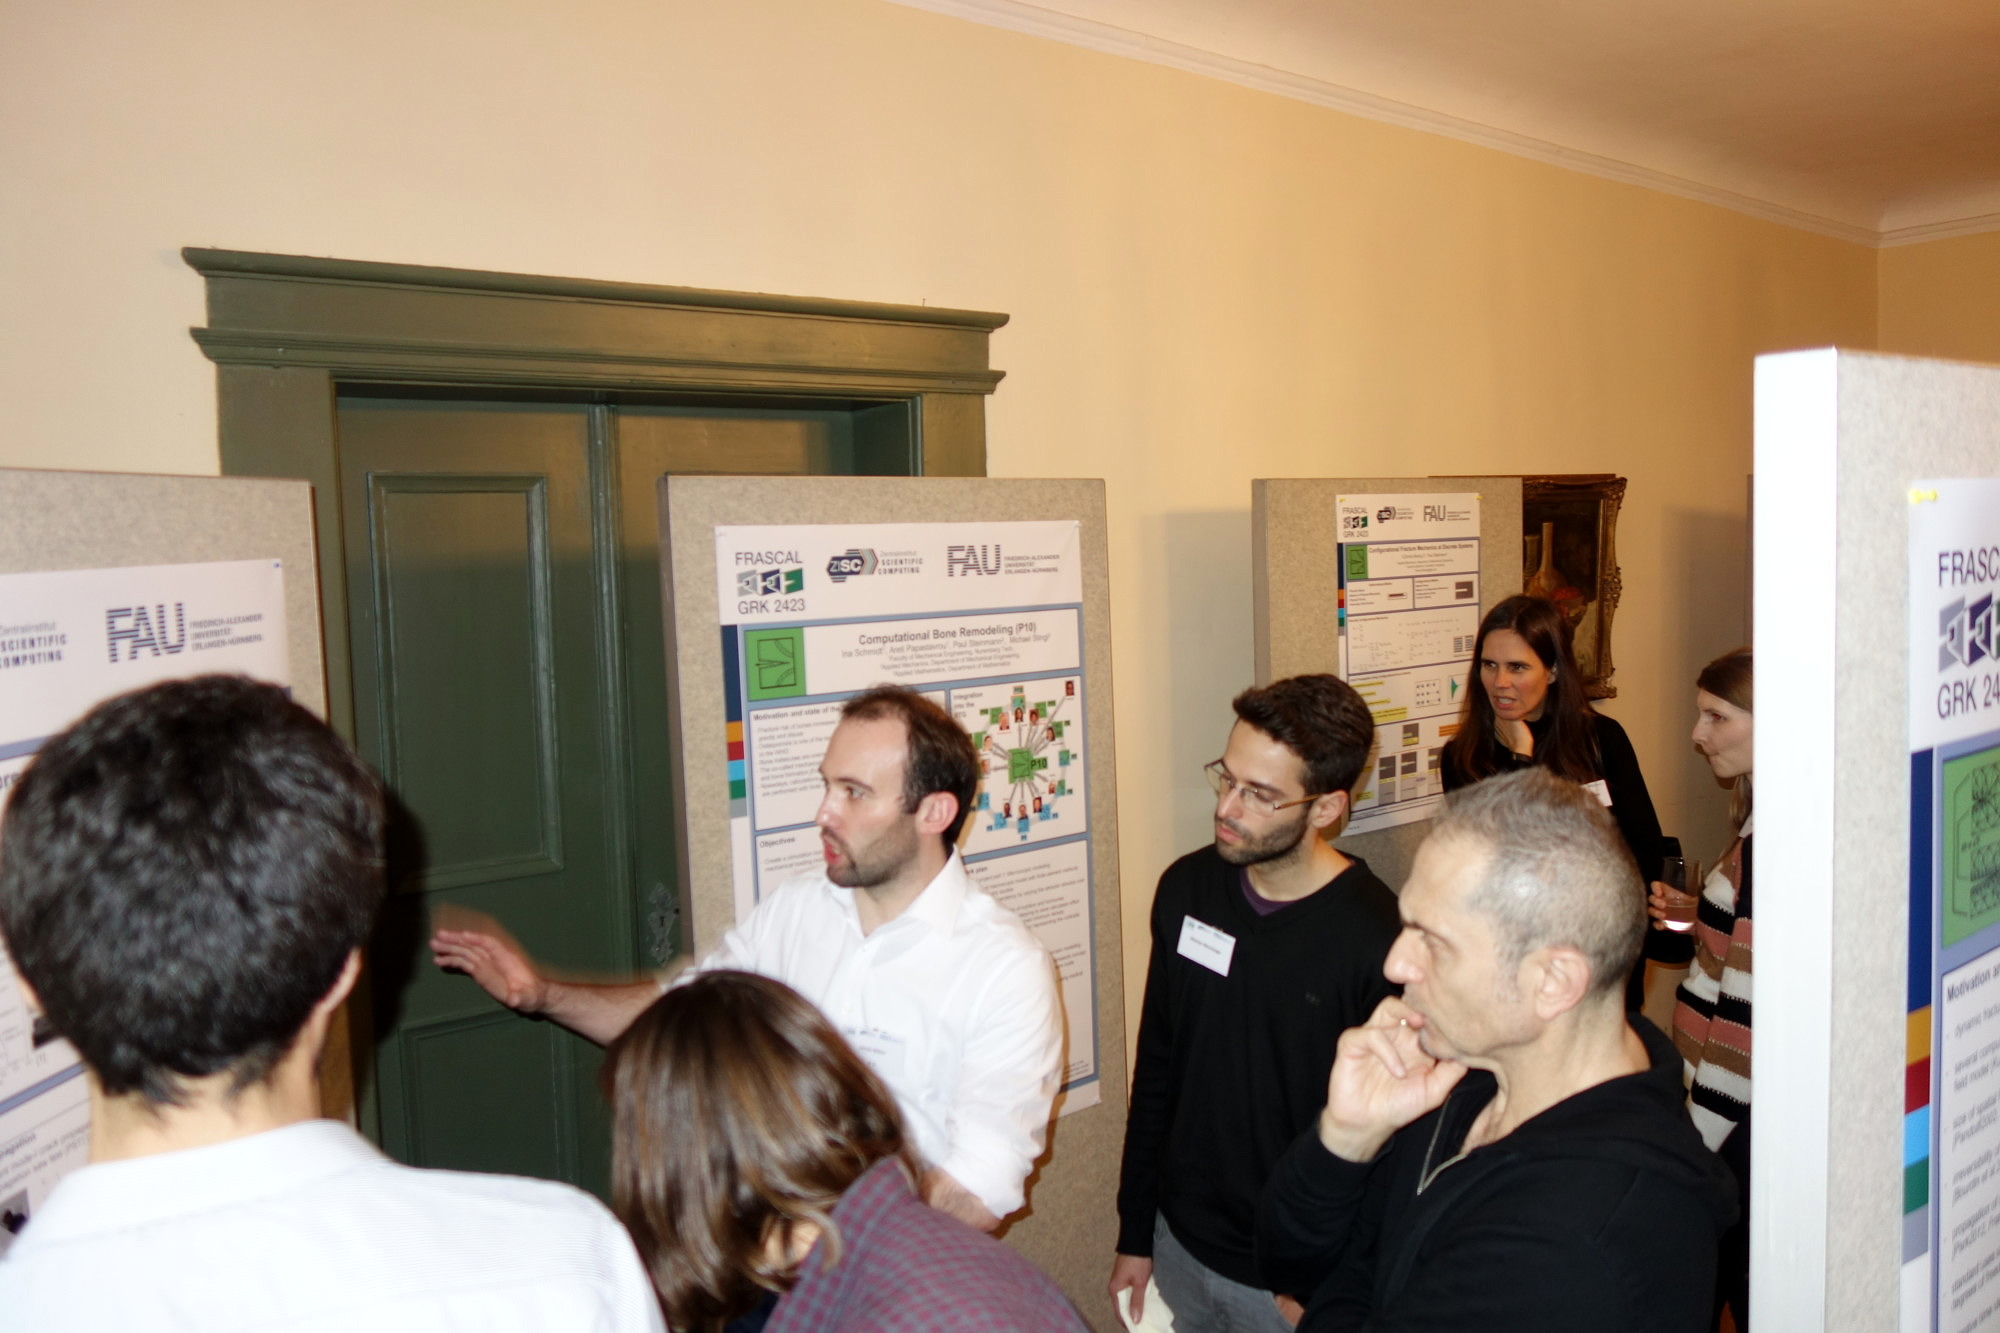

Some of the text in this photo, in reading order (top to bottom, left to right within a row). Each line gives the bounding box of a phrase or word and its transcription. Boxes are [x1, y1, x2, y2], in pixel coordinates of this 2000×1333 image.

[1424, 505, 1446, 521] FAU
[735, 551, 803, 566] FRASCAL
[881, 558, 923, 566] SCIENTIFIC
[947, 545, 1000, 577] FAU
[878, 567, 920, 575] COMPUTING
[1938, 546, 2000, 588] FRASC
[738, 599, 806, 615] GRK 2423
[106, 602, 186, 663] FAU
[858, 622, 1037, 646] Computational Bone Remodeling (P10)
[1, 634, 67, 652] SCIENTIFIC
[1937, 675, 1977, 720] GRK
[753, 711, 789, 721] Motivation
[804, 707, 820, 715] state
[822, 706, 829, 714] of
[1030, 758, 1047, 769] P10
[760, 837, 796, 849] Objectives
[1947, 969, 1990, 1001] Motivation
